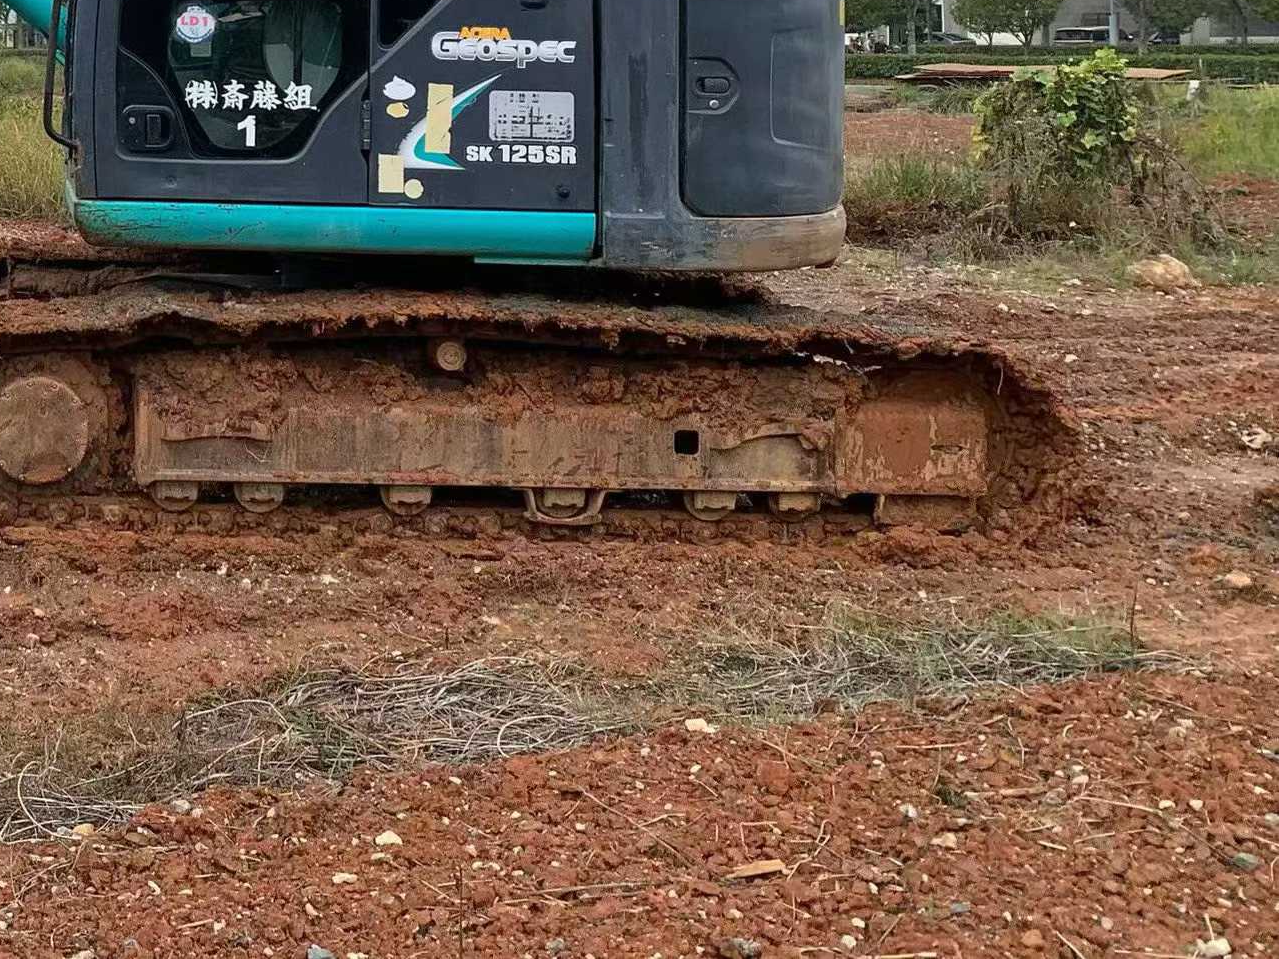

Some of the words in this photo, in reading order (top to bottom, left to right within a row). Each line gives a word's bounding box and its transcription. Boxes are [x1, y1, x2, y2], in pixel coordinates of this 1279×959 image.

[236, 115, 257, 147] 1
[466, 147, 499, 162] SK
[498, 144, 577, 165] 125SR
